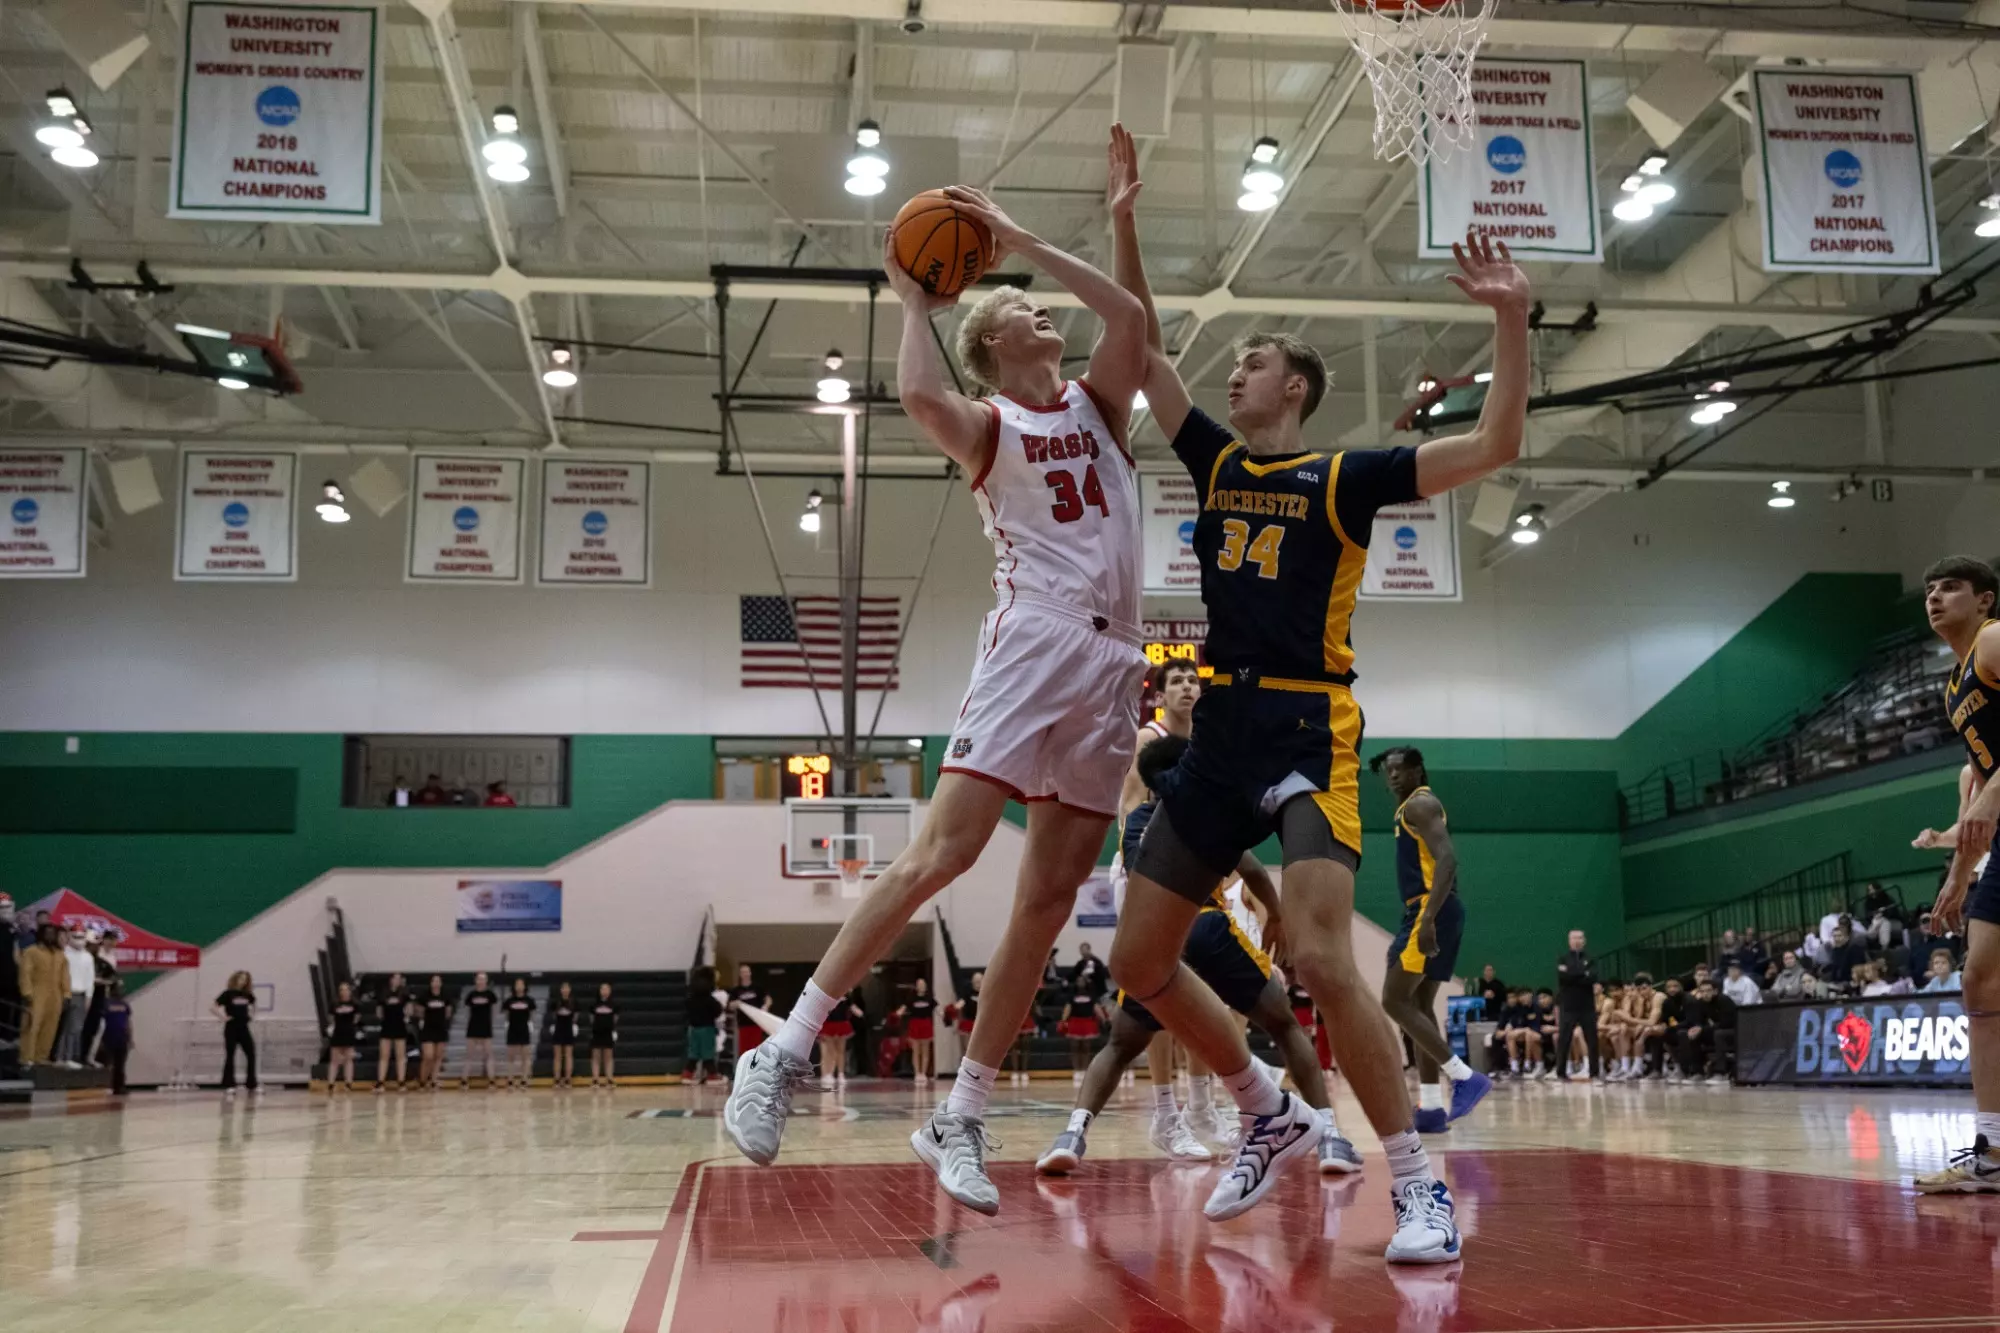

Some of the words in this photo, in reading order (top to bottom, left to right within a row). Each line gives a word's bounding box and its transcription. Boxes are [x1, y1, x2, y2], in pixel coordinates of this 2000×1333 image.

[225, 14, 341, 33] WASHINGTON
[231, 38, 332, 56] UNIVERSITY
[195, 62, 255, 77] WOMEN'S
[258, 65, 299, 78] CROSS
[303, 67, 365, 81] COUNTRY
[1787, 84, 1884, 100] WASHINGTON
[1795, 106, 1881, 121] UNIVERSITY
[257, 134, 297, 151] 2018
[233, 157, 319, 176] NATIONAL
[223, 180, 327, 200] CHAMPIONS
[1490, 180, 1526, 195] 2017
[1473, 201, 1547, 217] NATIONAL
[1832, 194, 1865, 209] 2017
[1467, 222, 1556, 239] CHAMPIONS
[1814, 216, 1887, 232] NATIONAL
[1810, 237, 1893, 254] CHAMPIONS
[1020, 429, 1100, 464] Wash
[206, 458, 275, 469] WASHINGTON
[436, 463, 503, 473] WASHINGTON
[208, 473, 270, 482] UNIVERSITY
[564, 468, 629, 477] WASHINGTON
[1297, 470, 1319, 483] UAA
[438, 477, 498, 487] UNIVERSITY
[566, 482, 625, 491] UNIVERSITY
[1044, 464, 1110, 524] 34
[1217, 517, 1286, 580] 34
[1385, 567, 1430, 578] NATIONAL
[1382, 582, 1434, 590] CHAMPIONS
[1964, 724, 1994, 770] 5
[801, 773, 824, 800] 18
[1884, 1015, 1971, 1062] BEARS
